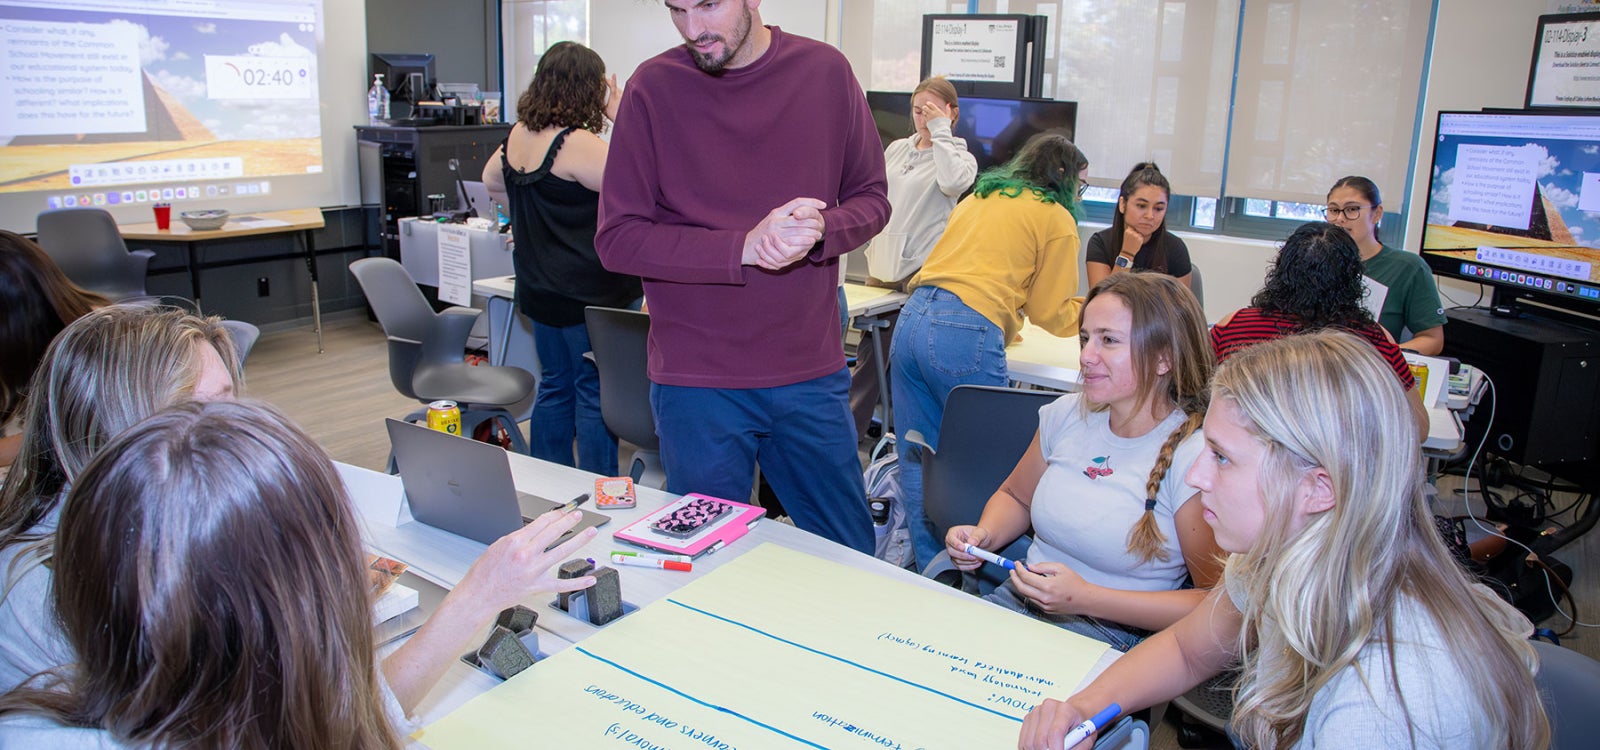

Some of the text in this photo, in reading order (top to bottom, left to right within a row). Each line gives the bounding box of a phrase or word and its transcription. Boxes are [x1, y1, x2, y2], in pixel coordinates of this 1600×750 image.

[5, 25, 43, 34] Consider
[8, 39, 115, 49] remnants of the Common
[8, 50, 39, 58] School
[87, 52, 100, 60] still
[10, 63, 25, 71] our
[28, 63, 78, 72] educational
[80, 64, 108, 74] system
[12, 75, 32, 83] How
[43, 75, 57, 83] the
[58, 76, 92, 85] purpose
[94, 75, 103, 84] of
[243, 68, 294, 86] 02:40
[16, 99, 57, 107] different?
[82, 99, 129, 108] implications
[17, 112, 39, 120] does
[79, 111, 89, 119] for
[92, 111, 105, 119] the
[106, 110, 135, 119] future?
[950, 664, 1043, 698] technology based
[583, 684, 648, 716] educators
[641, 711, 680, 730] and
